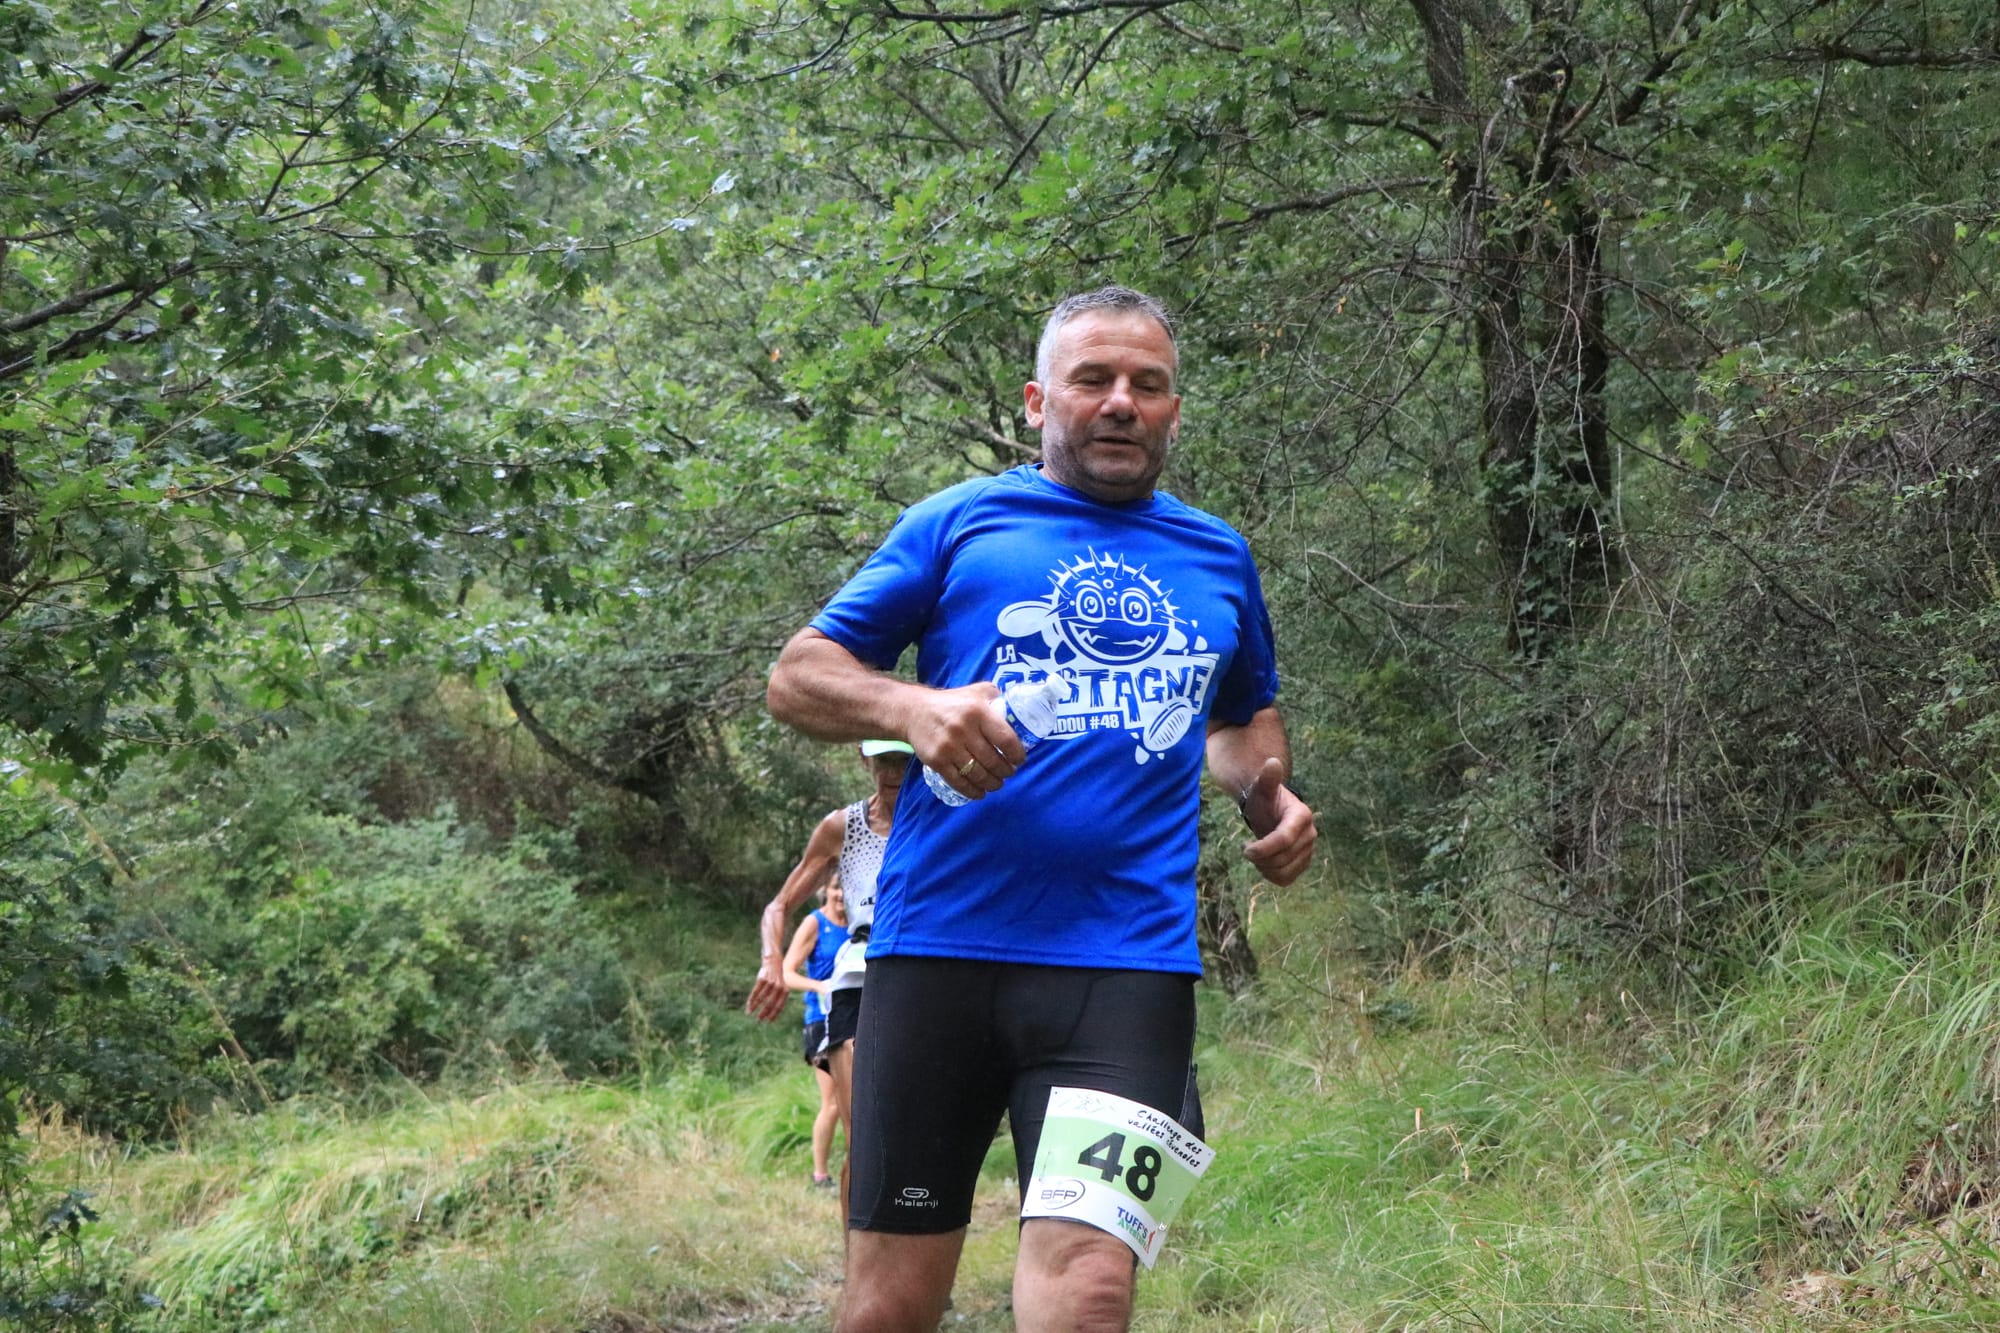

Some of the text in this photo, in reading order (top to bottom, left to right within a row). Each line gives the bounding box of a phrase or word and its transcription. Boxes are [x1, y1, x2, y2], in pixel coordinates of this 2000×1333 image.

[996, 644, 1018, 664] LA
[1089, 714, 1120, 730] #48
[1128, 1119, 1165, 1139] vallées
[1137, 1109, 1203, 1155] Challenge des
[1078, 1131, 1162, 1202] 48
[894, 1198, 939, 1209] Kalenji
[1041, 1189, 1077, 1200] BFP
